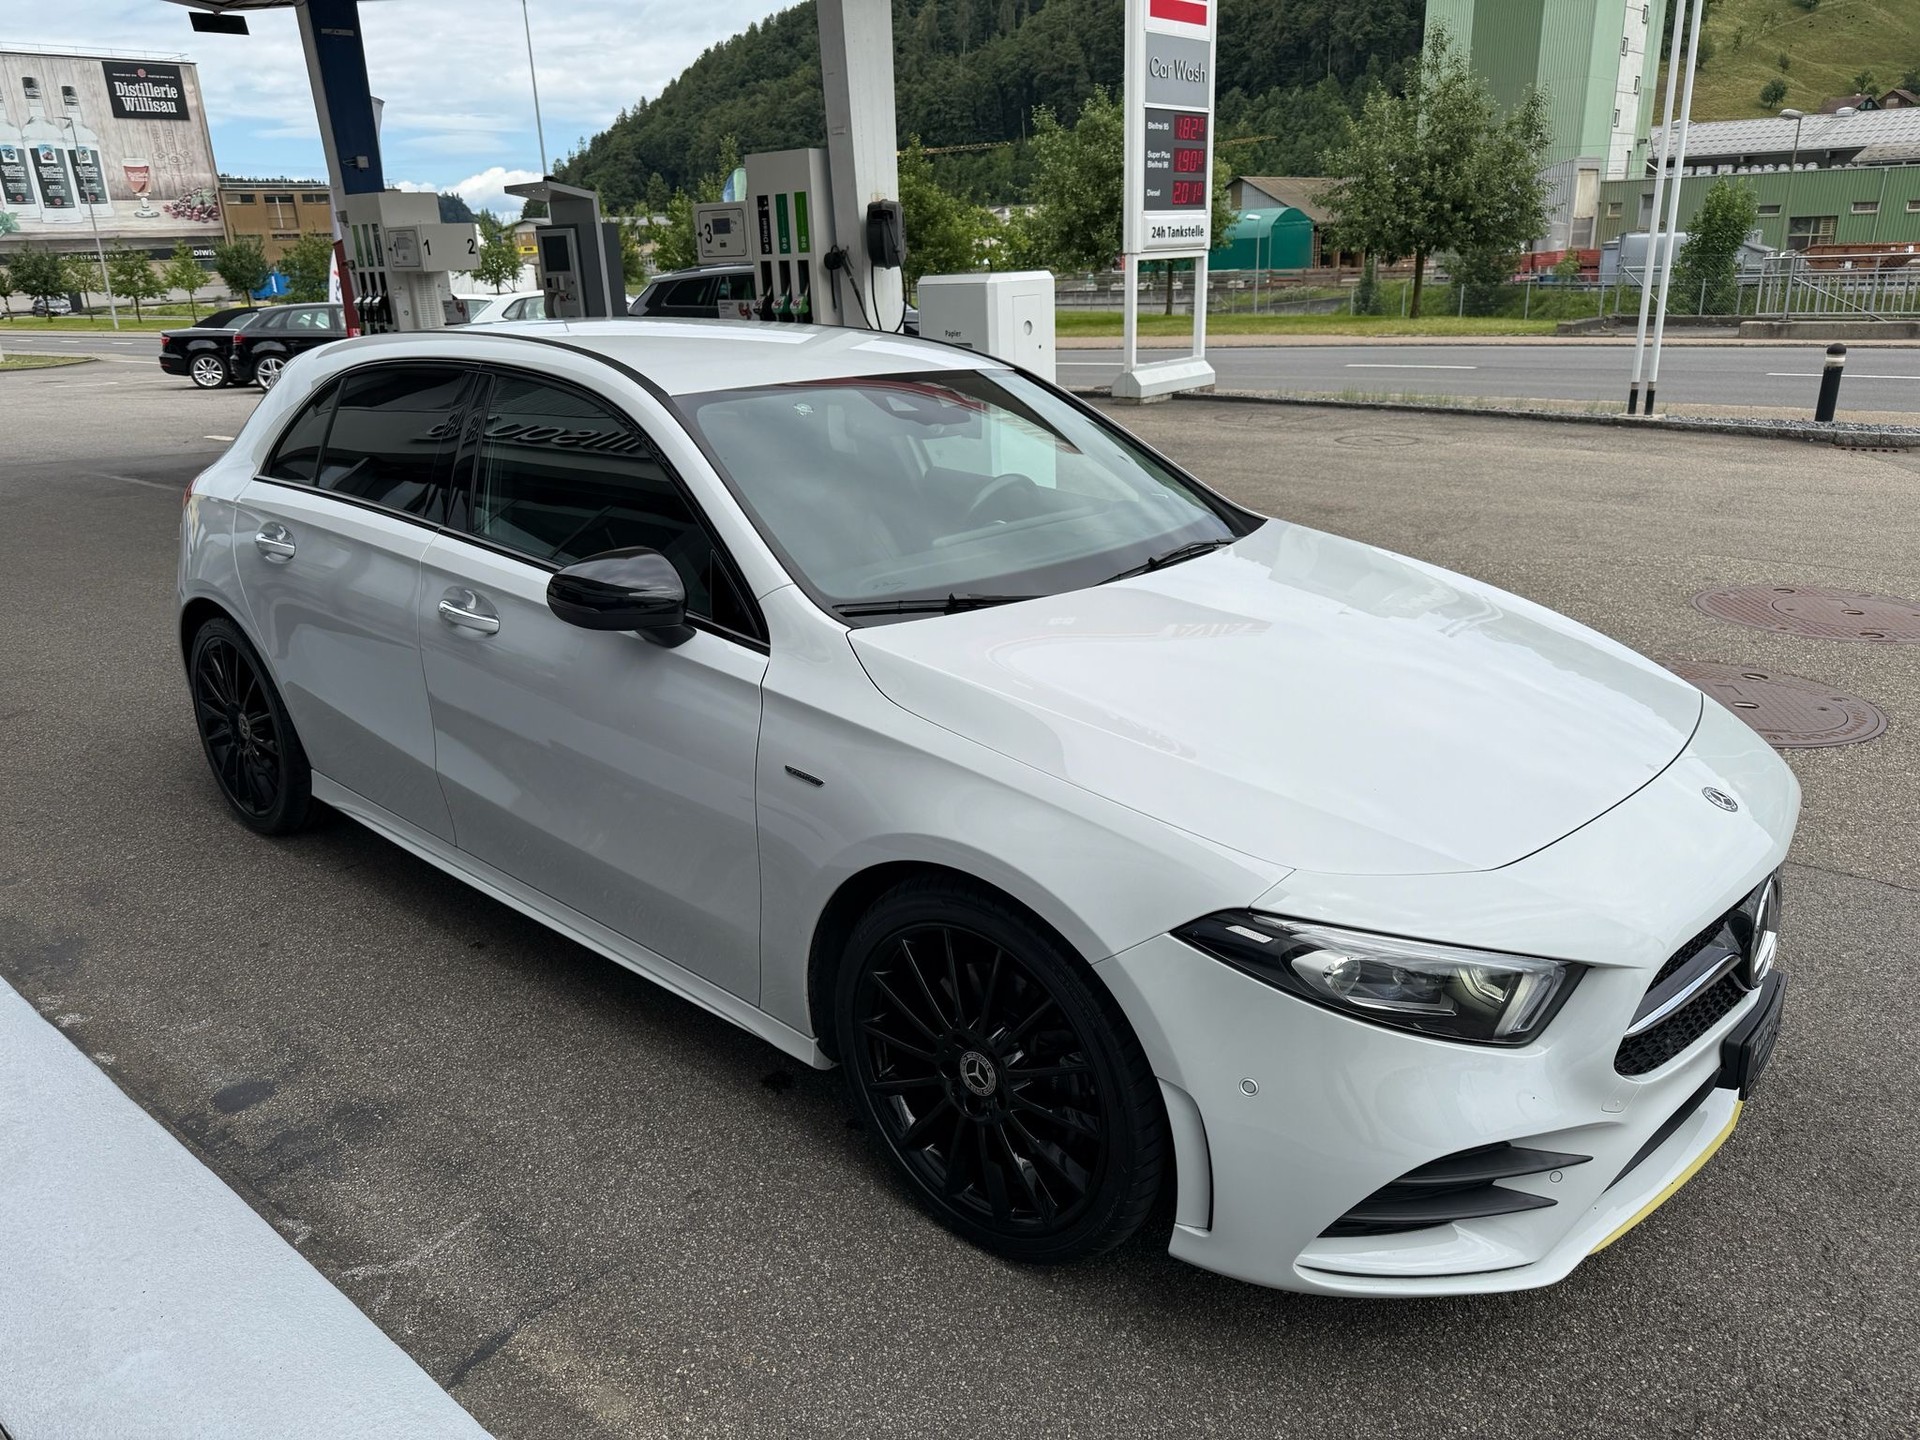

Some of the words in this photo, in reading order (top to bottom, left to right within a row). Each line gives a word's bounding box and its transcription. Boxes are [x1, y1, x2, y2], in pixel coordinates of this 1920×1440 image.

[1149, 56, 1172, 78] Car
[1174, 59, 1206, 83] Wash
[113, 81, 178, 99] Distillerie
[121, 97, 178, 113] Willisau
[1147, 150, 1161, 159] Super
[1161, 151, 1171, 159] Plus
[1146, 189, 1161, 197] Diesel
[704, 223, 713, 244] 3
[762, 217, 770, 243] Diesel
[1151, 225, 1166, 238] 24h
[1167, 224, 1205, 238] Tankstelle
[423, 239, 431, 256] 1
[466, 238, 476, 254] 2
[944, 330, 962, 339] Papier
